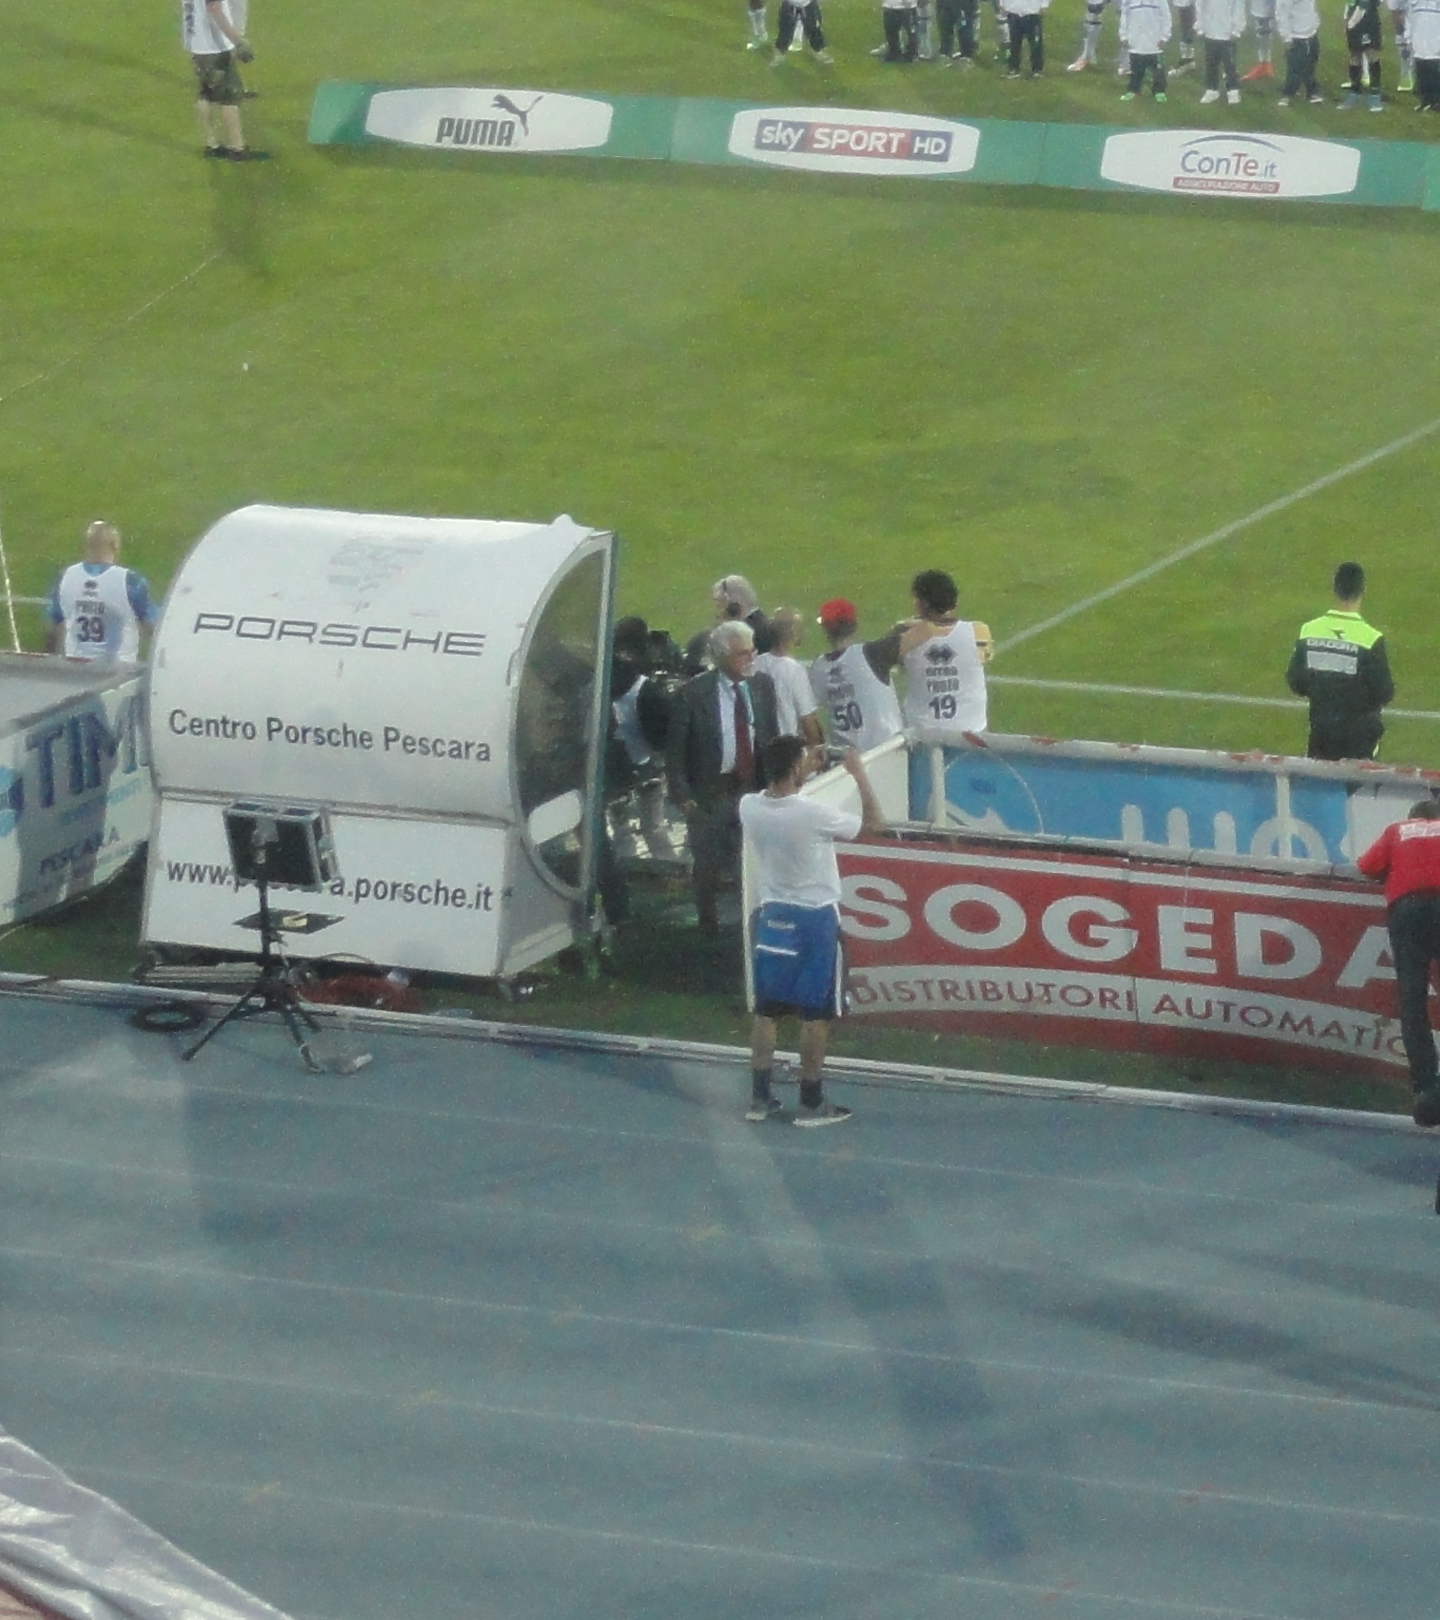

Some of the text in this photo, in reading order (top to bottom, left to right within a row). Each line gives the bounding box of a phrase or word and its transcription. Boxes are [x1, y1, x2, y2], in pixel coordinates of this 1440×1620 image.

[435, 117, 515, 147] PUMA
[761, 121, 948, 156] sky SPORT HD
[1180, 149, 1278, 179] ConTe.it
[193, 612, 487, 657] PORSCHE
[834, 700, 864, 731] 50
[928, 694, 958, 720] 19
[168, 708, 493, 764] Centro Porsche Pescara
[851, 976, 1135, 1012] DISTRIBUTORI
